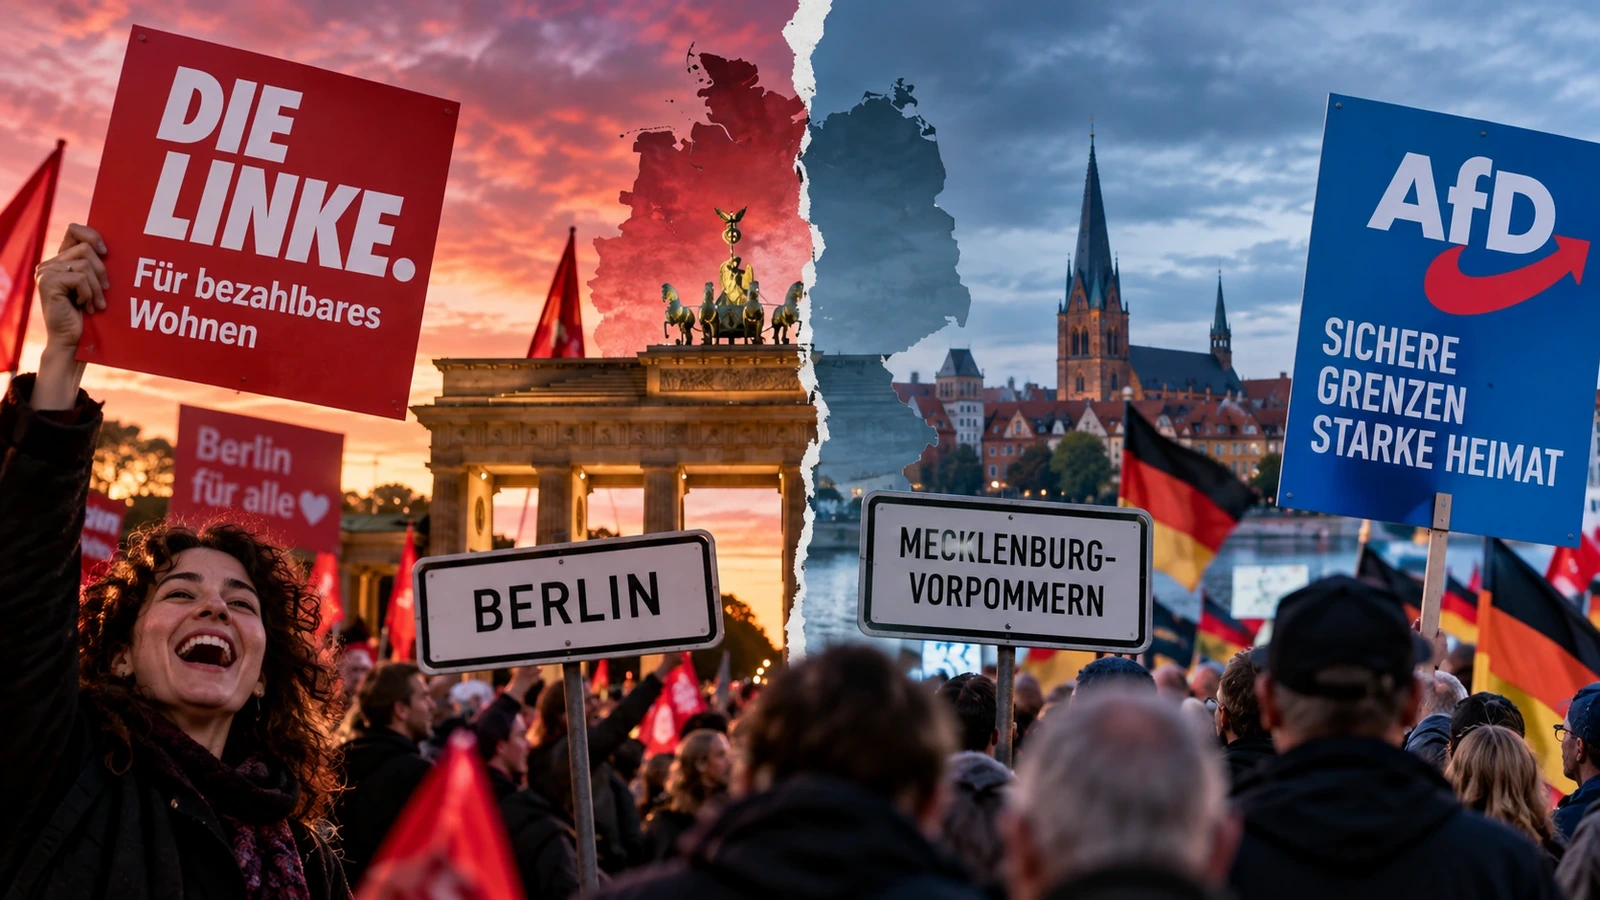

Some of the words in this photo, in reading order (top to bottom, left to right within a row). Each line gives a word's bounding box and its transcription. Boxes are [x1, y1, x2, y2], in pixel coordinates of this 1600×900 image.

[156, 65, 303, 164] DIE
[143, 150, 416, 282] LINKE.
[1366, 151, 1556, 255] AfD
[129, 297, 258, 349] Wohnen
[133, 257, 188, 295] Für
[195, 268, 381, 330] bezahlbares
[1322, 316, 1460, 375] SICHERE
[1317, 365, 1467, 425] GRENZEN
[196, 425, 292, 476] Berlin
[1310, 414, 1436, 470] STARKE
[1445, 434, 1564, 487] HEIMAT
[192, 467, 238, 507] für
[242, 479, 295, 519] alle
[900, 526, 1117, 572] MECKLENBURG-
[473, 571, 661, 633] BERLIN
[909, 572, 1104, 617] VORPOMMERN
